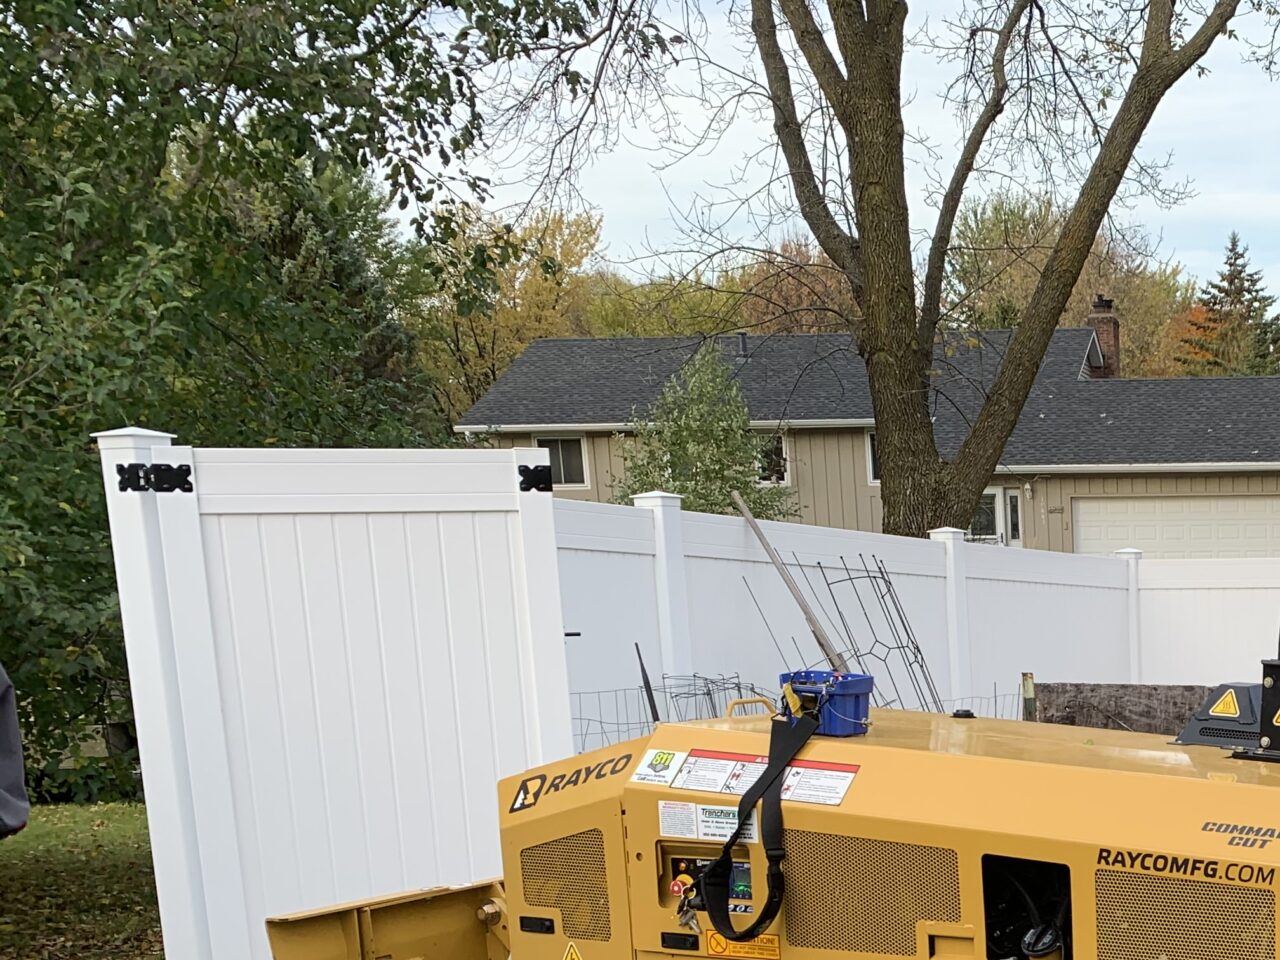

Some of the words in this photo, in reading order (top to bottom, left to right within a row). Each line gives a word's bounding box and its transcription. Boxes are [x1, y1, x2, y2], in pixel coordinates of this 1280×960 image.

[651, 752, 675, 767] 811
[543, 753, 633, 796] RAYCO
[1227, 836, 1273, 849] CUT
[1096, 848, 1276, 886] RAYCOMFG.COM
